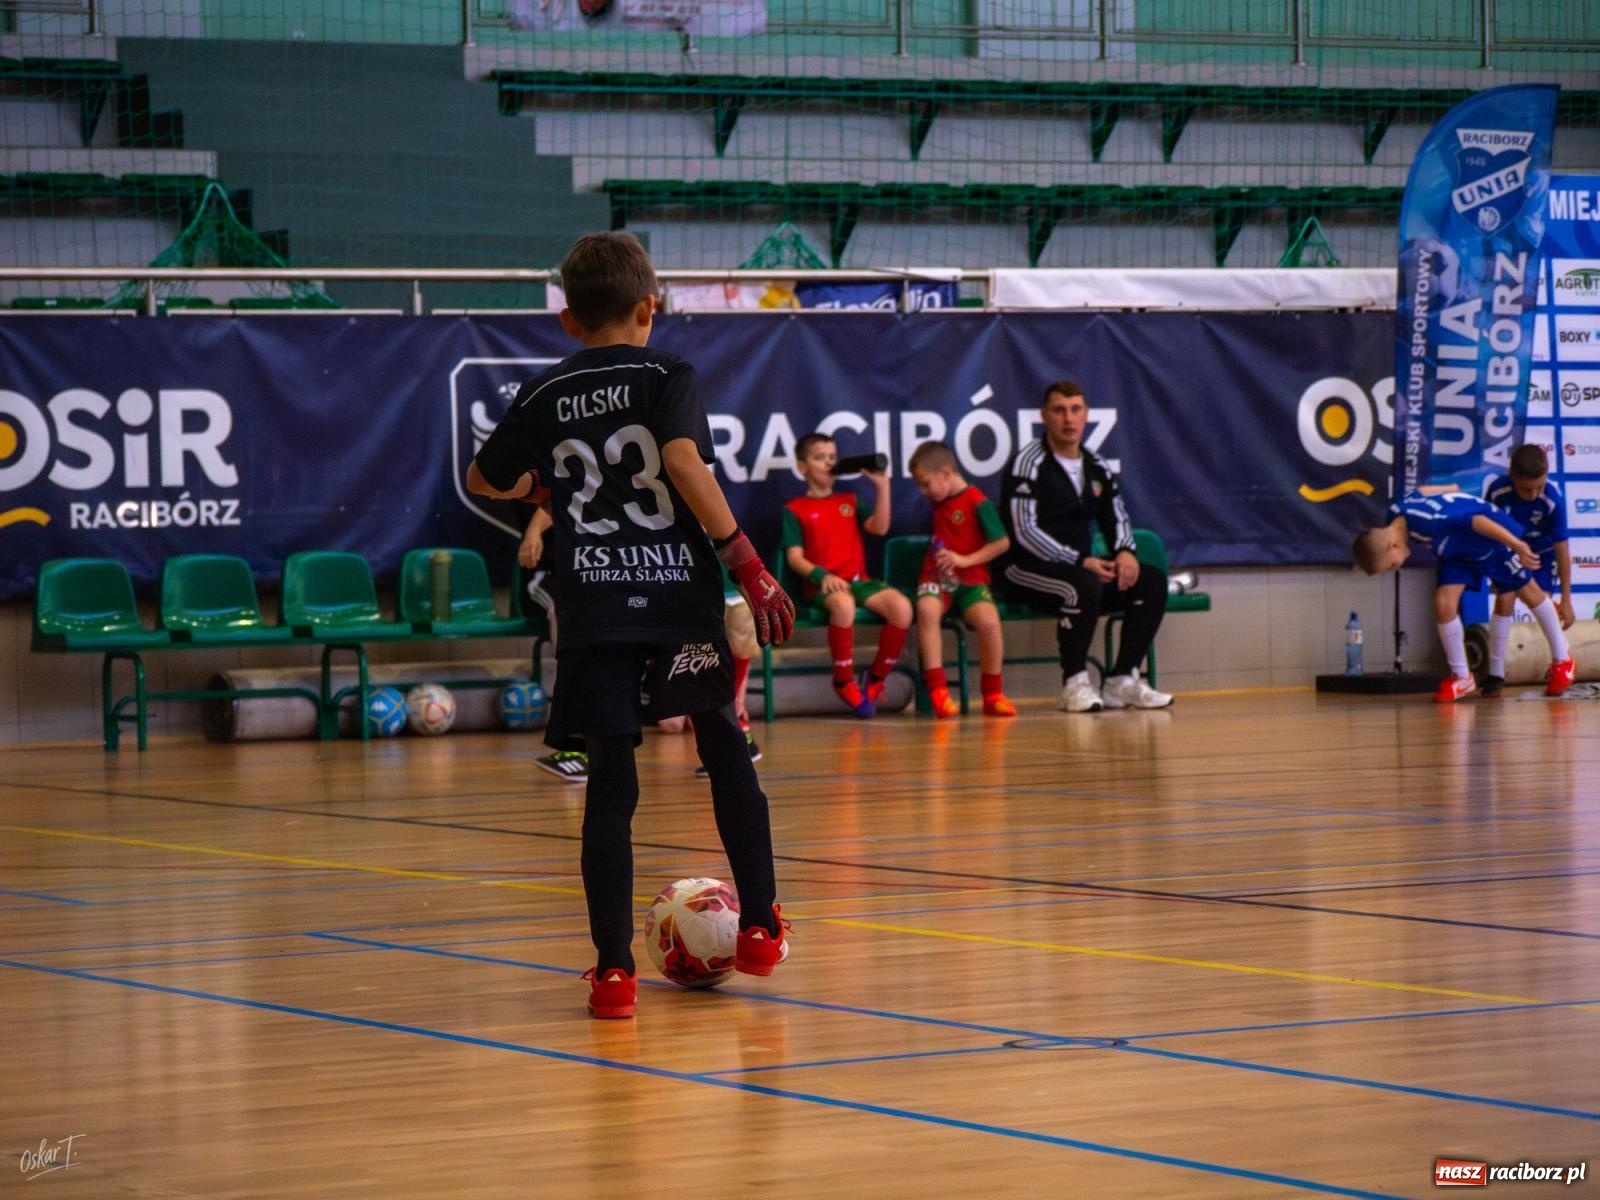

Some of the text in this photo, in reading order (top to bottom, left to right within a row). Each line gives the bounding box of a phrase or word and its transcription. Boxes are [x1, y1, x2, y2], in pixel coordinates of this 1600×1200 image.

[1463, 133, 1529, 146] RACIBORZ
[1458, 169, 1520, 206] UNIA
[1411, 249, 1434, 357] SPORTOWY
[1559, 331, 1591, 343] BOXY
[1407, 361, 1426, 417] KLUB
[1432, 298, 1483, 456] UNIA
[556, 385, 631, 422] CILSKI
[552, 424, 675, 535] 23
[70, 492, 241, 529] RACIBÓRZ
[573, 543, 695, 570] KS UNIA
[580, 565, 690, 584] TURZA ŚLĄSKA
